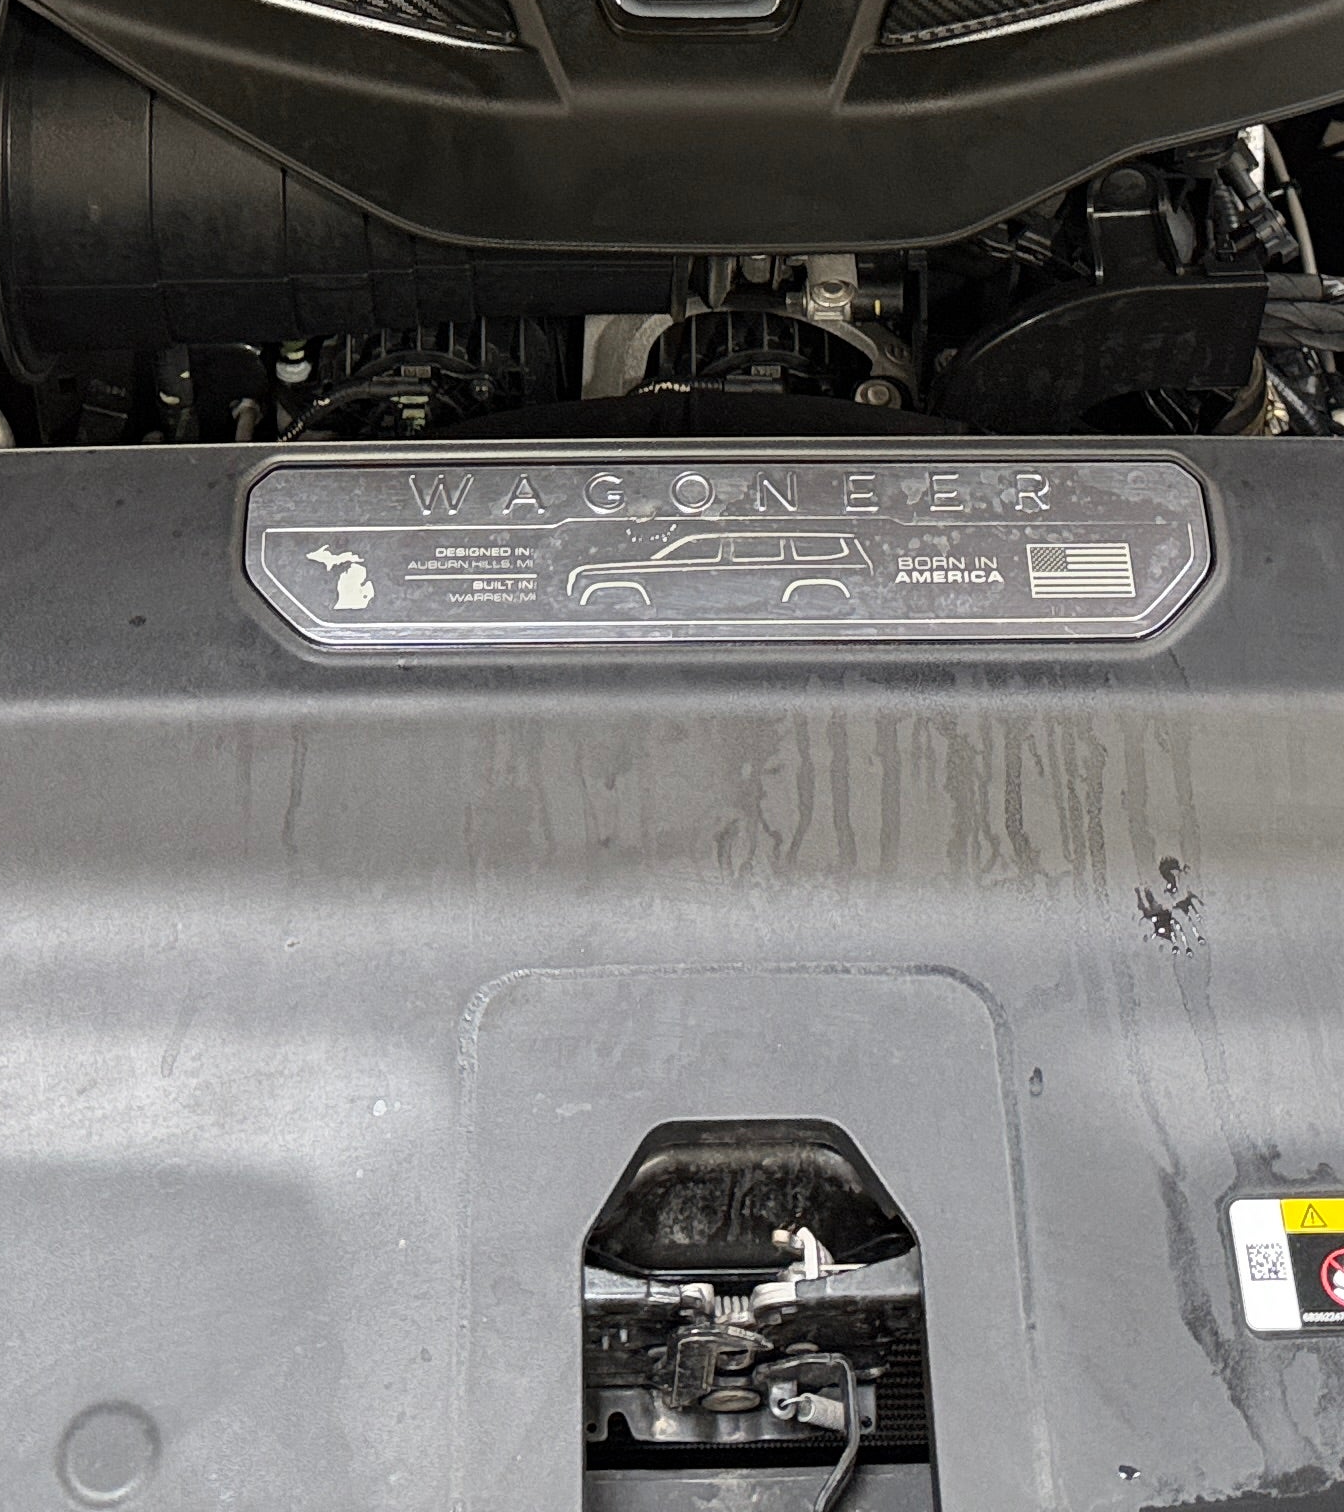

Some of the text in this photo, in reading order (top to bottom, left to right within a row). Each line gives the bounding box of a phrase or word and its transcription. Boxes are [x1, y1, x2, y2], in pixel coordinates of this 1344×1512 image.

[408, 471, 1051, 515] WAGONEER
[435, 547, 535, 558] DESIGNED IN:
[407, 559, 469, 570] AUBURN
[516, 559, 534, 569] MI
[897, 556, 998, 570] BORN IN
[894, 571, 1005, 585] AMERICA
[472, 580, 537, 591] BUILT IN:
[519, 592, 537, 602] MI
